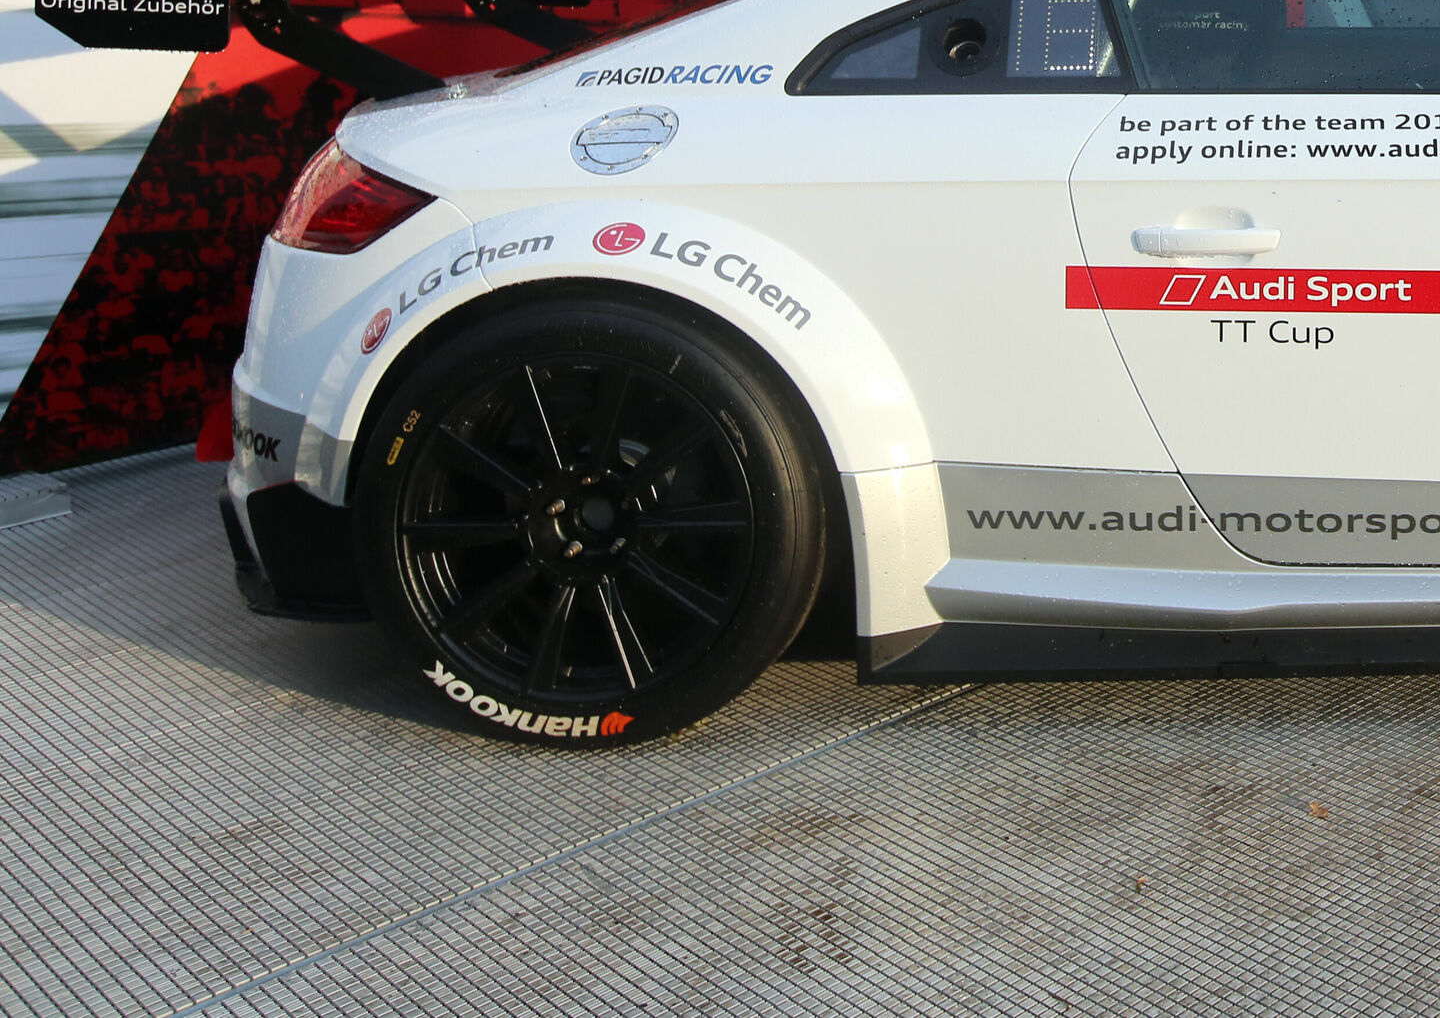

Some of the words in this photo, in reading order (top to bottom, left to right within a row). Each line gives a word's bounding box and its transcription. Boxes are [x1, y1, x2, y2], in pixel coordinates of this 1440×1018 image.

[1119, 115, 1152, 132] be
[1160, 116, 1218, 137] part
[1225, 114, 1255, 132] of
[1261, 114, 1307, 131] the
[1314, 114, 1386, 131] team
[1114, 139, 1193, 165] apply
[1200, 139, 1297, 159] online:
[399, 266, 443, 316] LG
[449, 234, 555, 277] Chem
[649, 232, 712, 268] LG
[713, 253, 812, 331] Chem
[1209, 276, 1295, 301] Audi
[1306, 276, 1413, 307] Sport
[1210, 319, 1257, 344] TT
[1268, 319, 1336, 349] Cup
